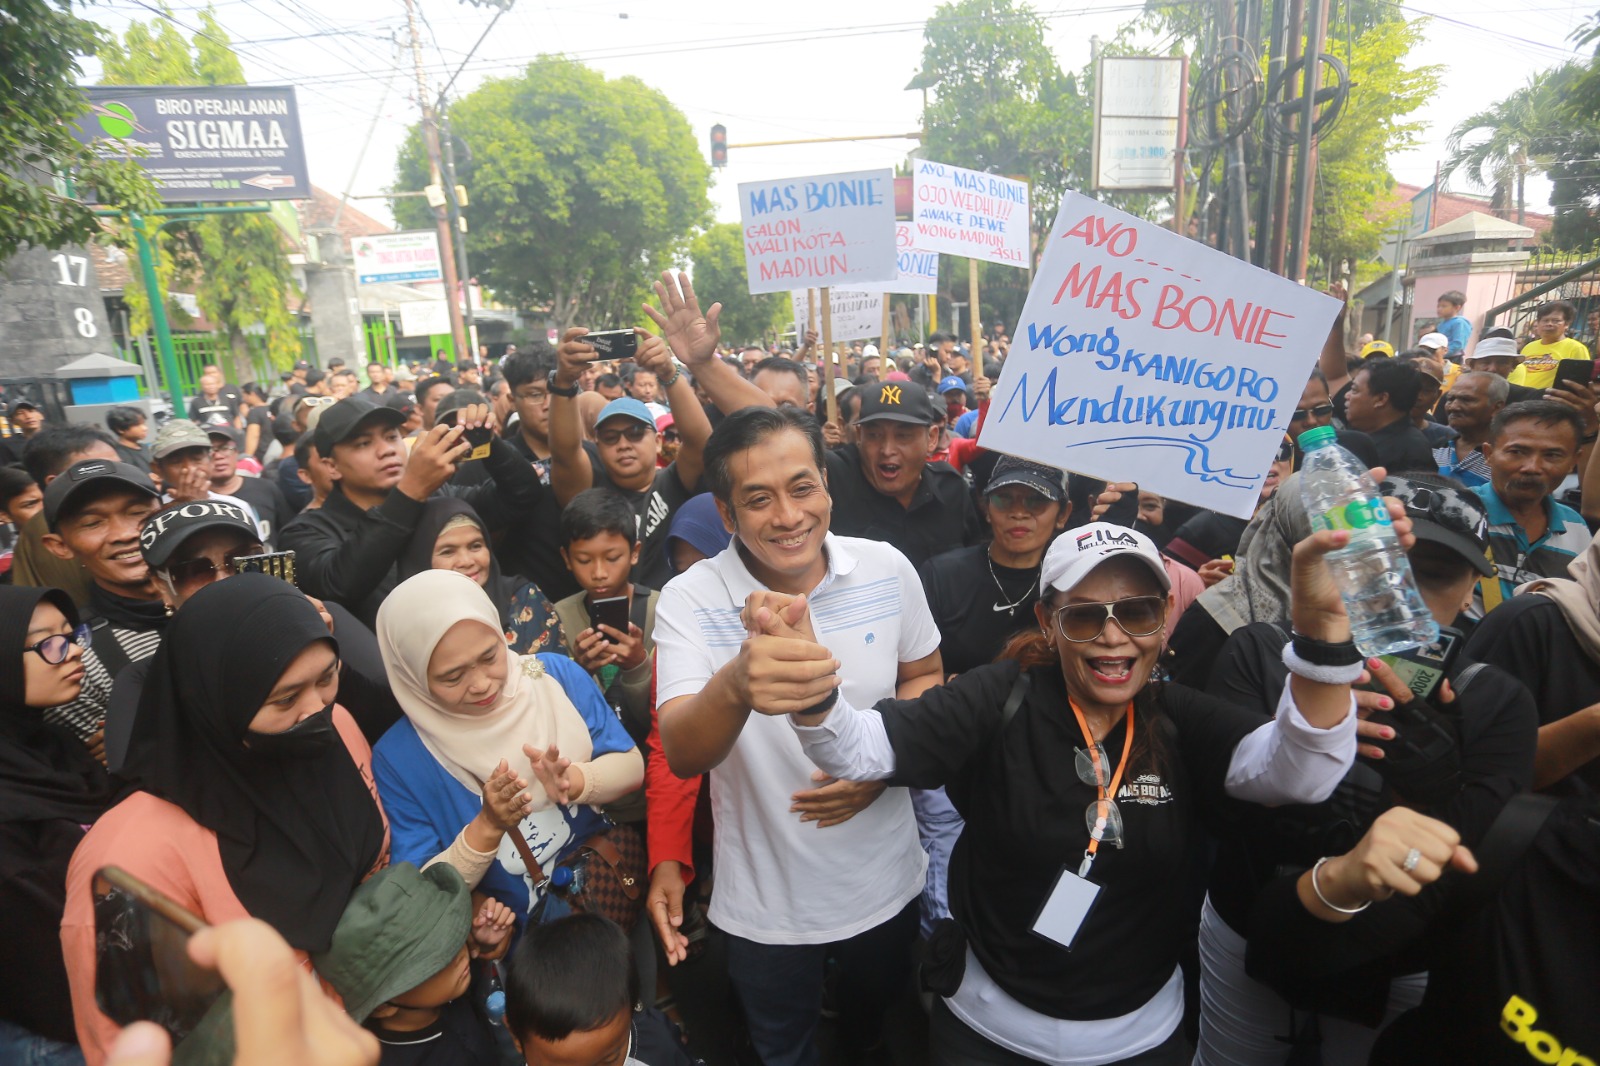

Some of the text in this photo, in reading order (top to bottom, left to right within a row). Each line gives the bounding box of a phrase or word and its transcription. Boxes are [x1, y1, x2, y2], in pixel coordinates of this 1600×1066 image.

[155, 98, 288, 115] BIRO PERJALANAN
[166, 120, 288, 149] SIGMAA
[174, 150, 221, 158] EXECUTIVE
[221, 150, 253, 158] TRAVEL
[750, 178, 883, 216] MAS BONIE
[918, 184, 947, 205] OJO
[954, 171, 986, 193] MAS
[989, 178, 1026, 205] BONIE
[919, 208, 1007, 233] AWAKE DEWE
[917, 222, 1005, 248] WONG MADIUN
[51, 253, 87, 286] 17
[1052, 262, 1295, 349] MAS BONIE
[74, 307, 97, 338] 8
[1028, 322, 1279, 403] Wong KANIGORO
[880, 385, 901, 404] NY
[140, 503, 251, 550] SPORT
[1076, 529, 1138, 547] FILA
[1118, 784, 1139, 798] MAS
